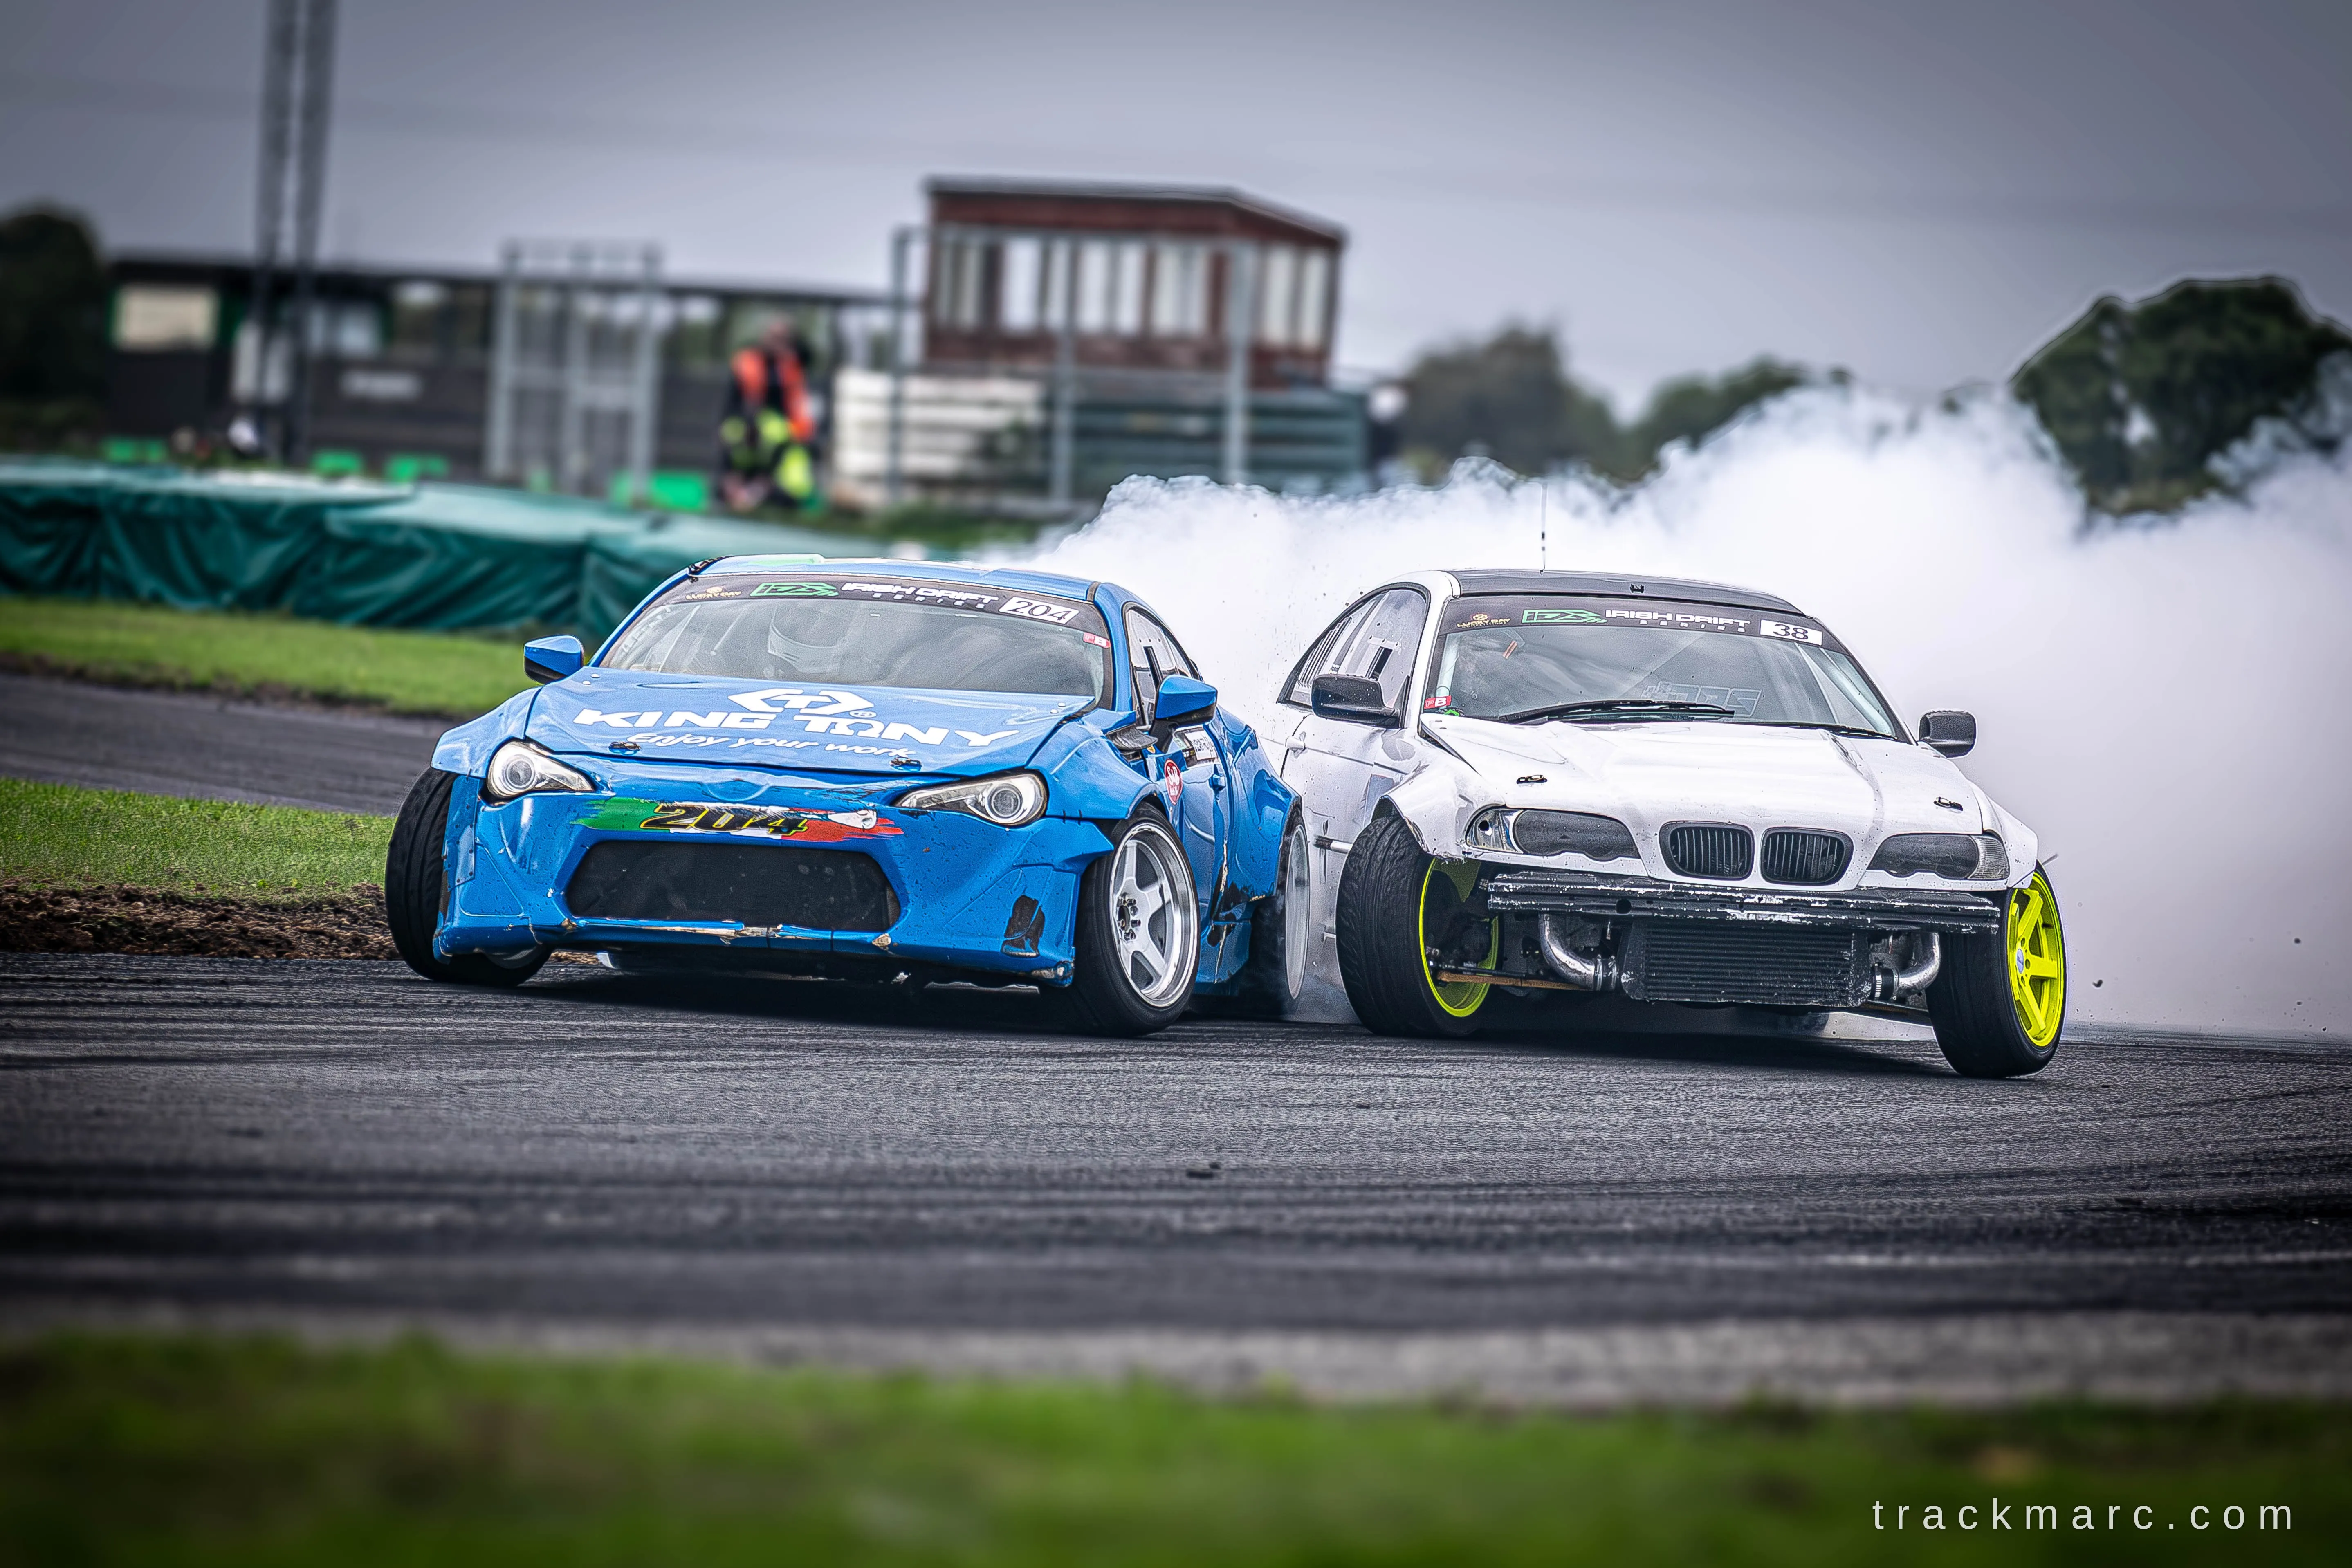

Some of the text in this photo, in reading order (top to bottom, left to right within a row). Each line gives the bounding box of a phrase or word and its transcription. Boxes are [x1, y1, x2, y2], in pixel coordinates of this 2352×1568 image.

[841, 582, 999, 603] IRISH DRIFT
[1007, 601, 1072, 621] 204
[1605, 610, 1751, 627] IRISH DRIFT
[1772, 624, 1809, 640] 38
[573, 709, 777, 729] KING
[627, 732, 916, 757] Enjoy your work
[640, 803, 808, 837] 204
